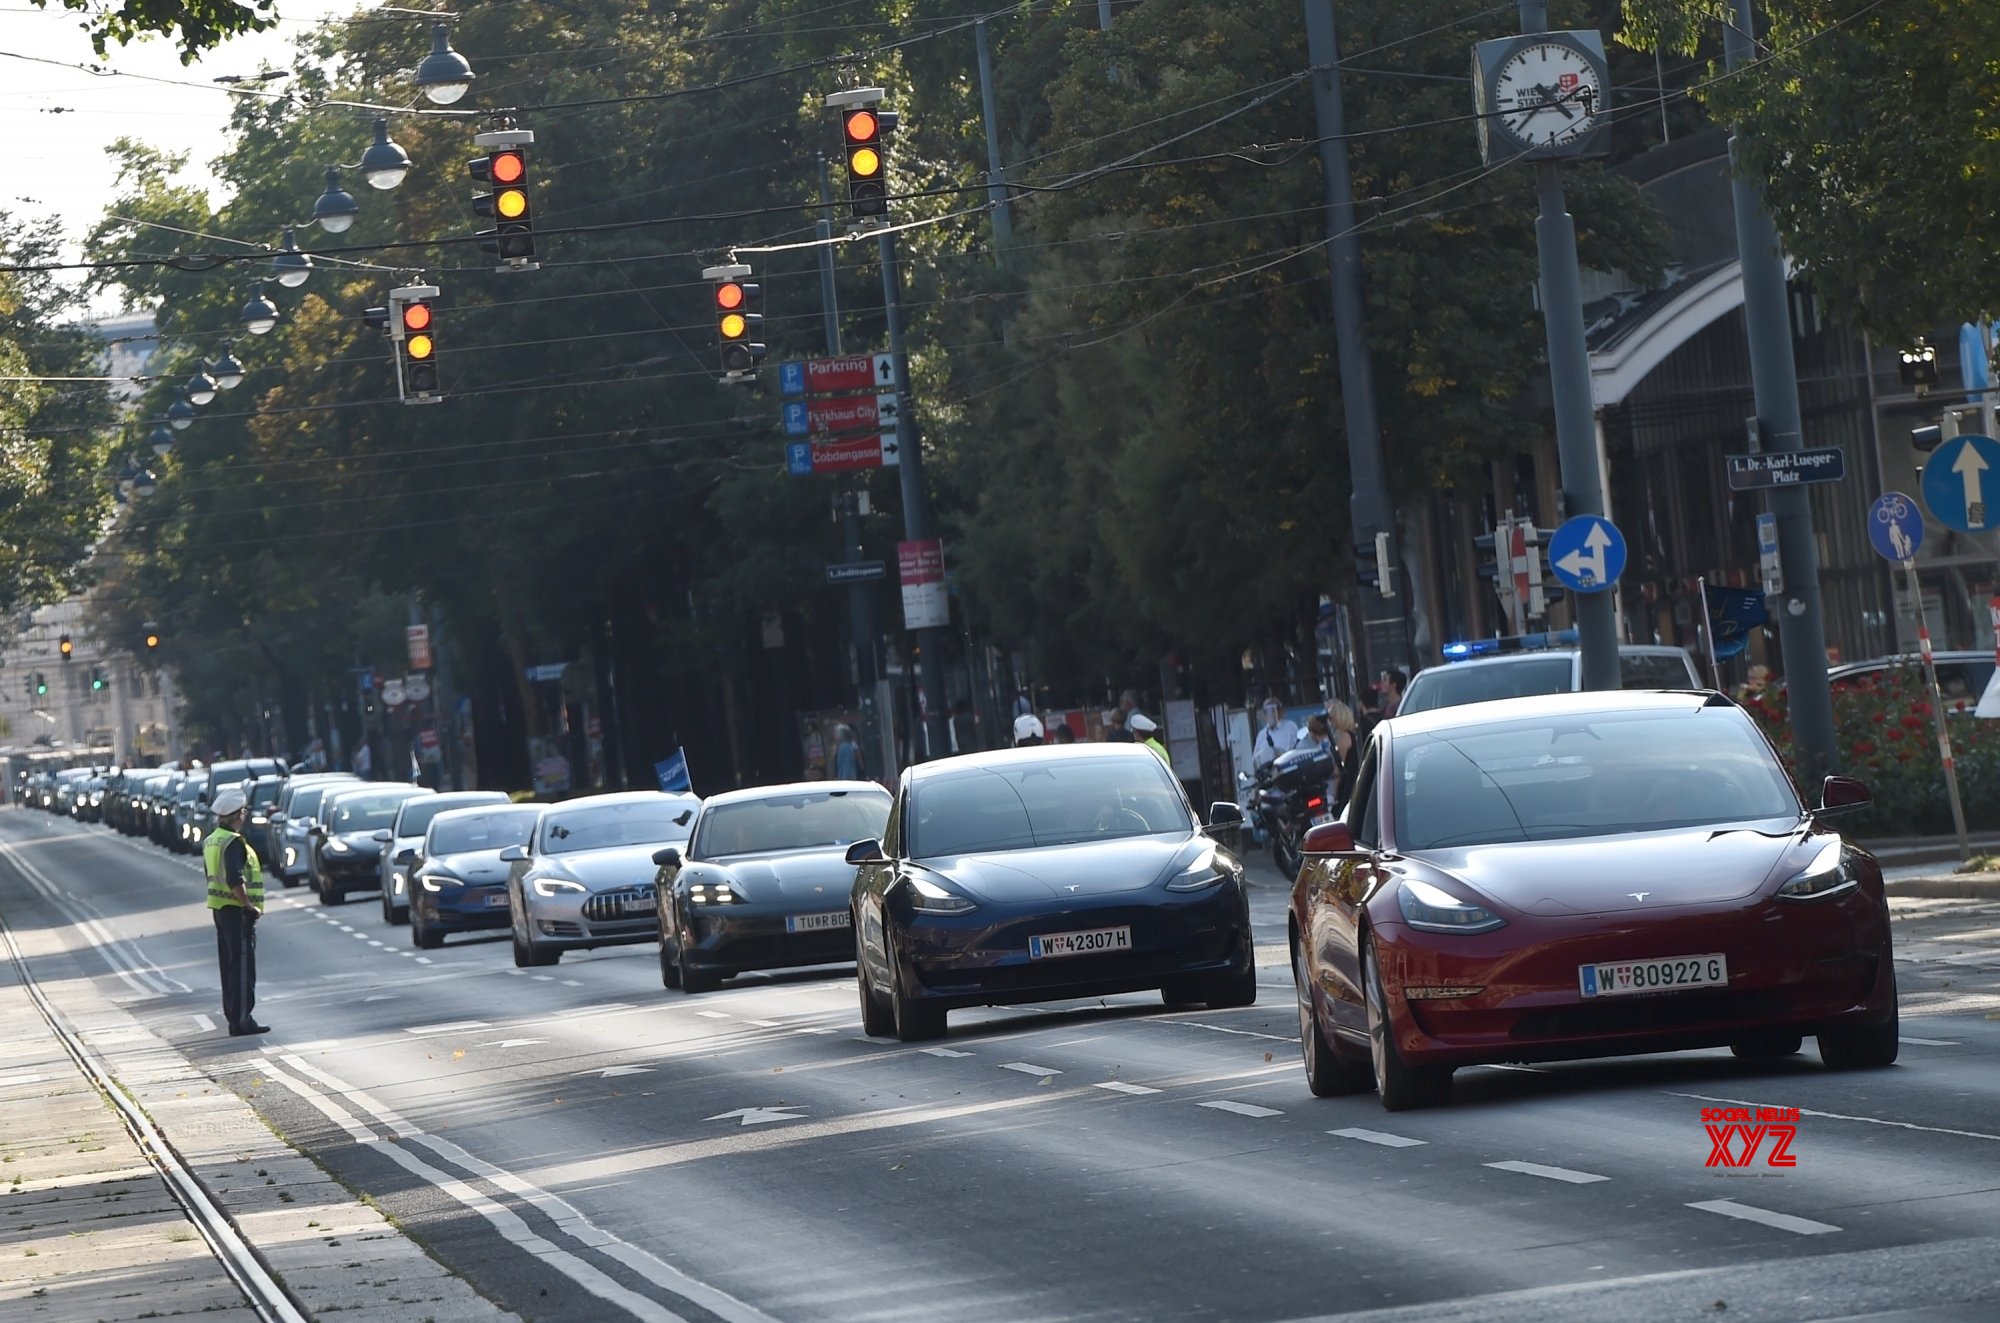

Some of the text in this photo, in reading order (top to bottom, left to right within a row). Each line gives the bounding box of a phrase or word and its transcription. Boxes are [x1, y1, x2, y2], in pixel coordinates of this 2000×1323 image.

[808, 359, 867, 375] Parkring
[857, 406, 877, 418] City
[812, 448, 880, 463] Cobdengasse
[1772, 470, 1800, 483] Platz
[1042, 938, 1053, 954] W
[1066, 932, 1113, 951] 42307
[1116, 930, 1126, 946] H
[1598, 968, 1614, 991] W
[1632, 960, 1702, 987] 80922
[1707, 959, 1720, 981] G
